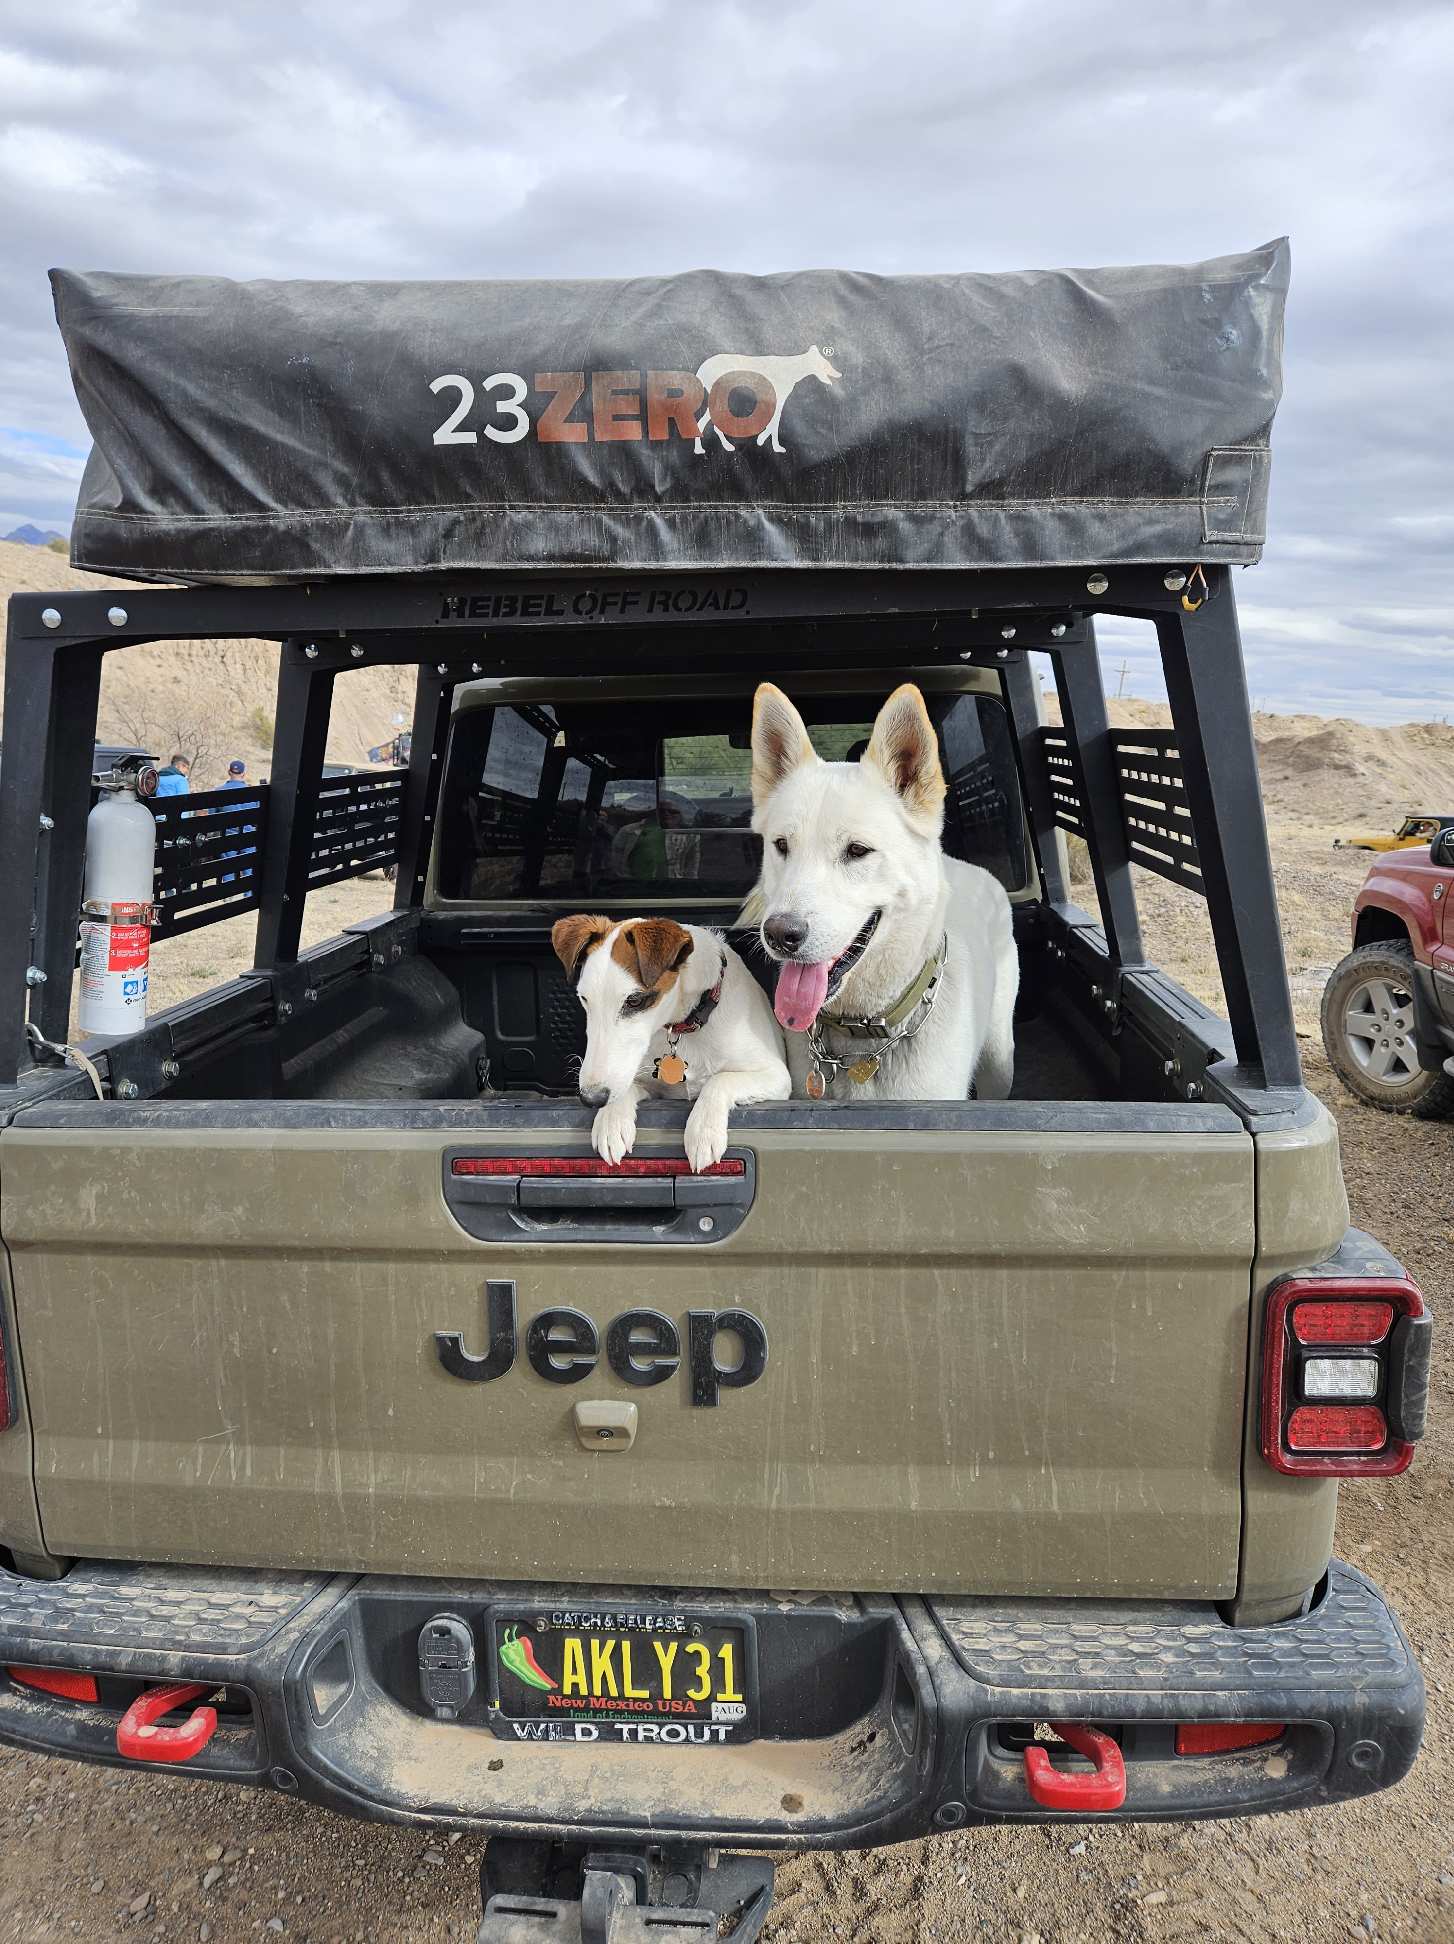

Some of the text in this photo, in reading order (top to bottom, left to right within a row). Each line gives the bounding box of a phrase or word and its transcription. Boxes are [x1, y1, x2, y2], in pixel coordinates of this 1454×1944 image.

[428, 369, 778, 445] 23ZERO
[440, 588, 748, 619] REBEL OFF ROAD
[433, 1279, 769, 1407] Jeep
[552, 1611, 686, 1631] CATCH & RELEASE
[562, 1638, 743, 1702] AKLY31
[547, 1695, 698, 1713] New Mexico USA
[720, 1705, 744, 1714] AUG
[512, 1722, 733, 1743] WILD TROUT
